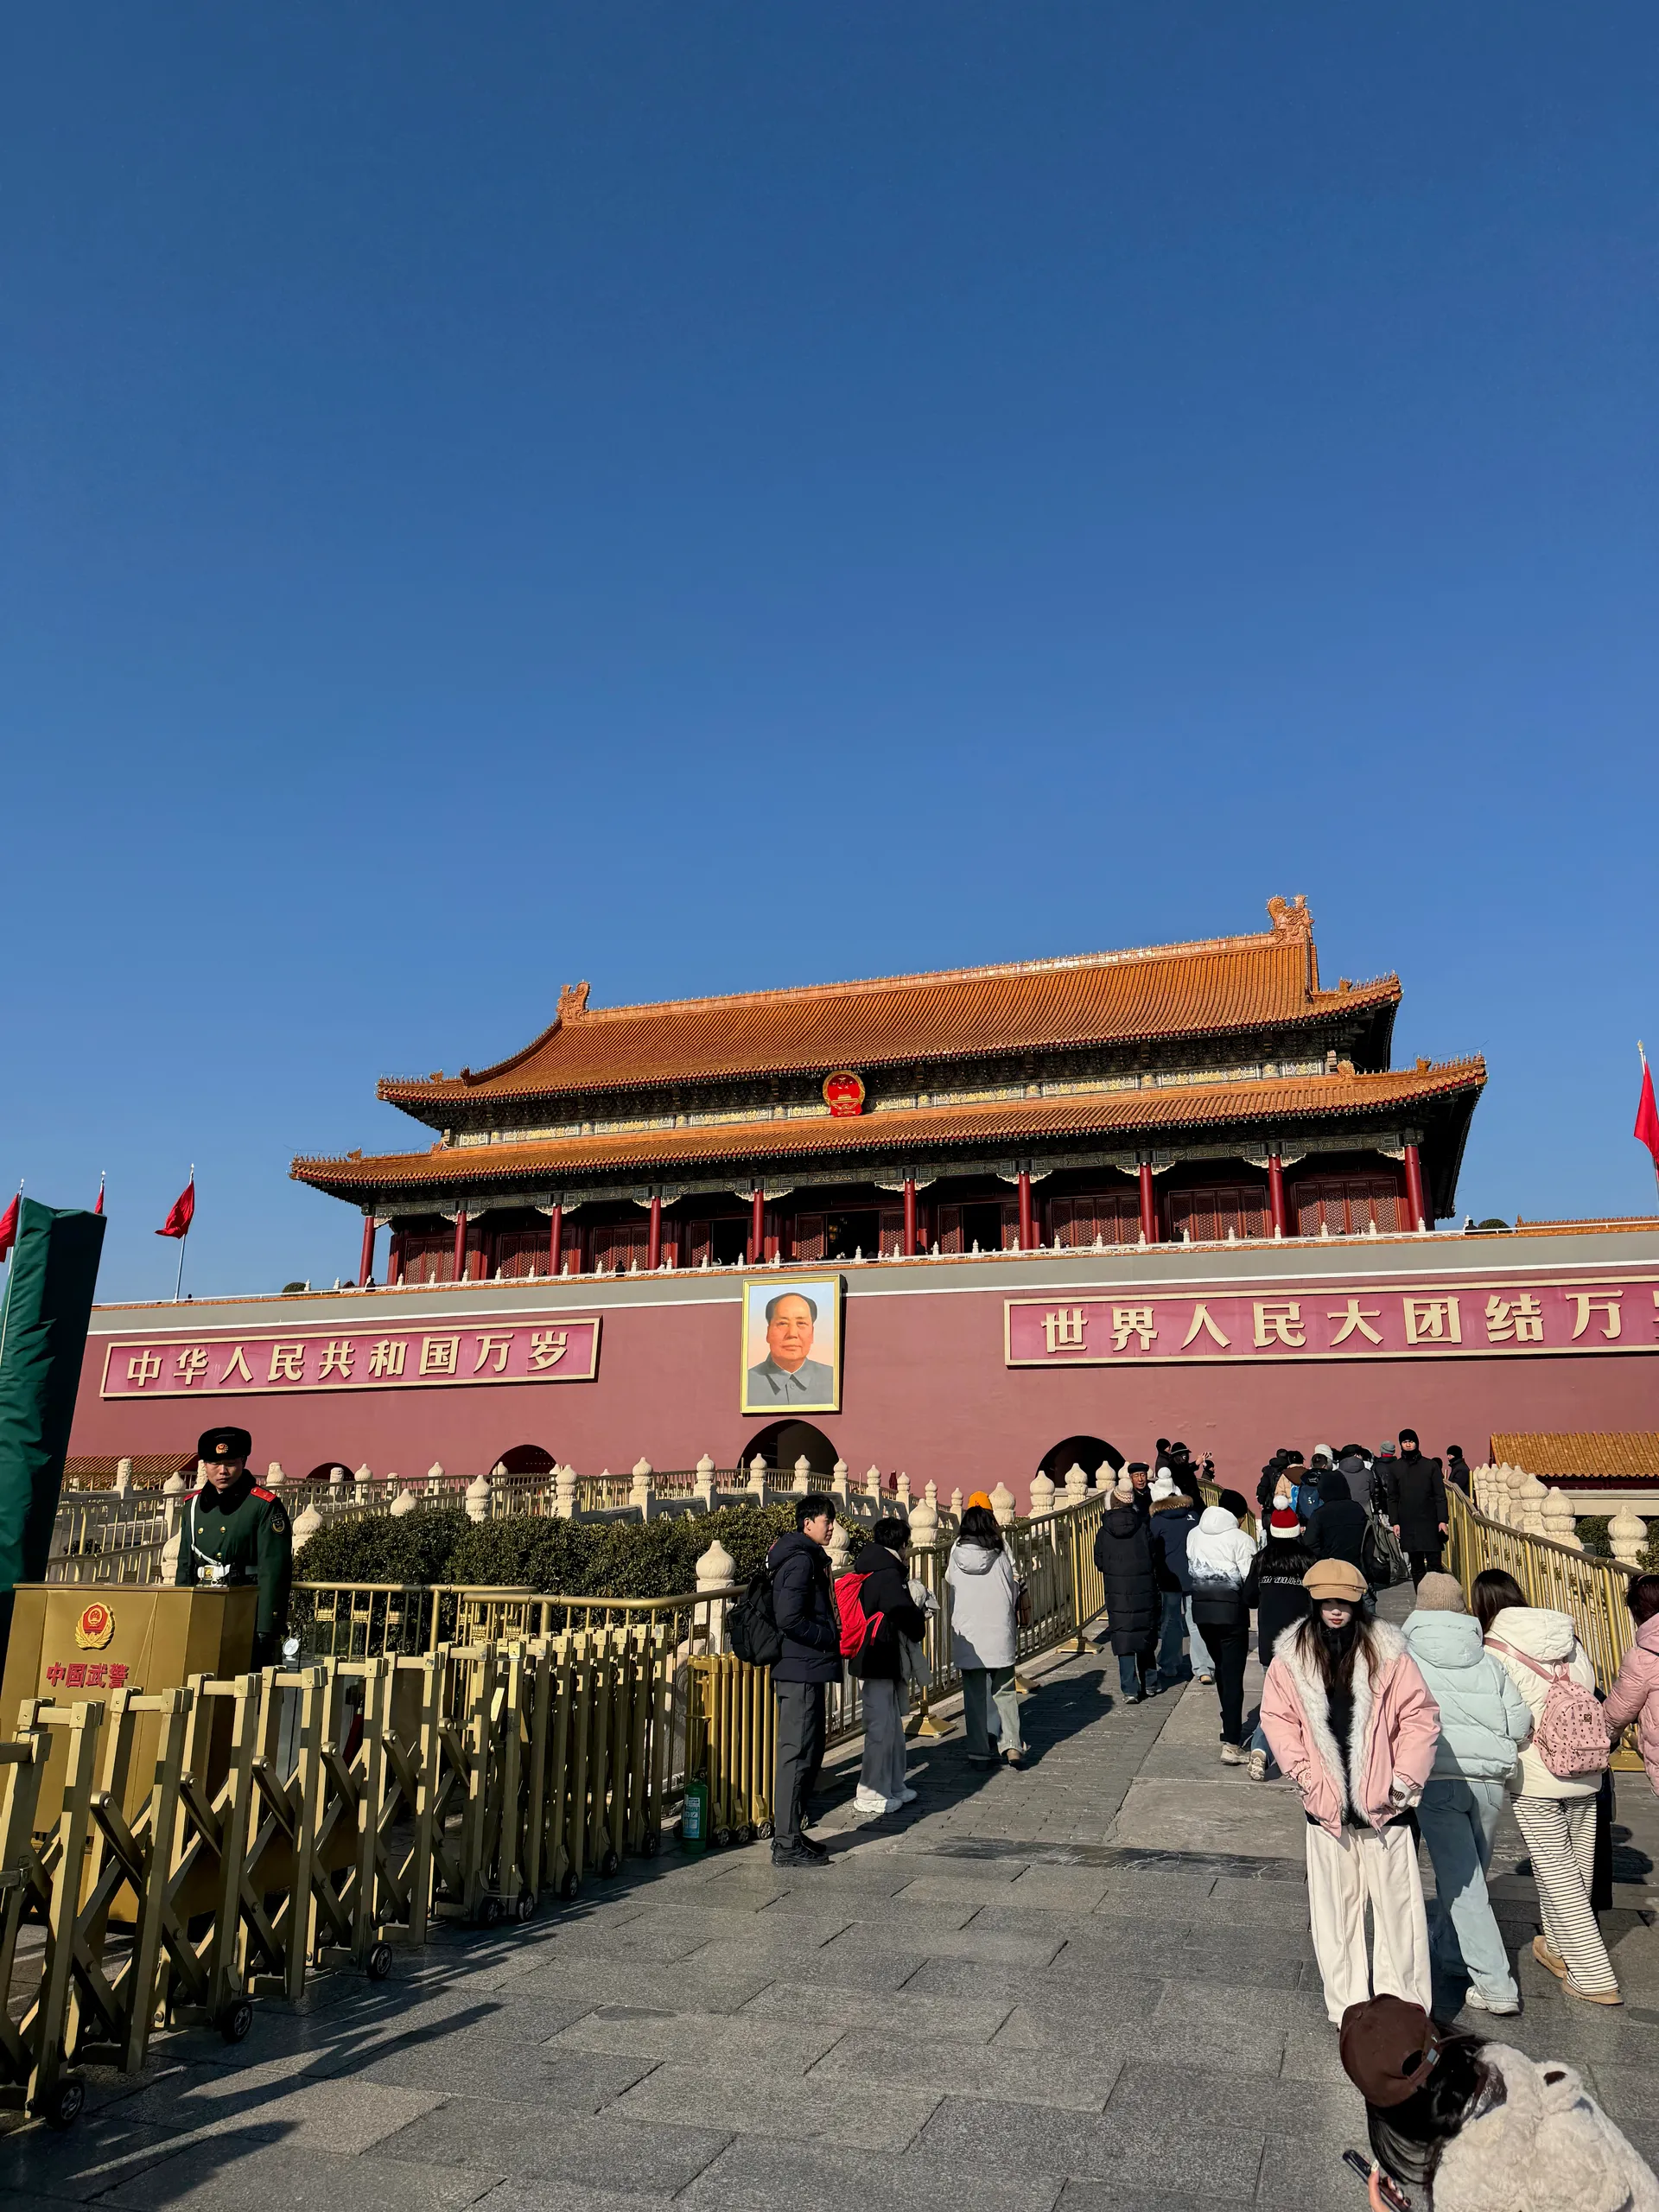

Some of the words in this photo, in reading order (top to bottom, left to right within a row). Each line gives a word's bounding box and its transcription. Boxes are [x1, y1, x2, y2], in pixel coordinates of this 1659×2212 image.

[1040, 1289, 1659, 1354] 世界人民大团结万
[126, 1331, 569, 1387] 中华人民共和国万岁
[46, 1662, 129, 1688] 中国武警
